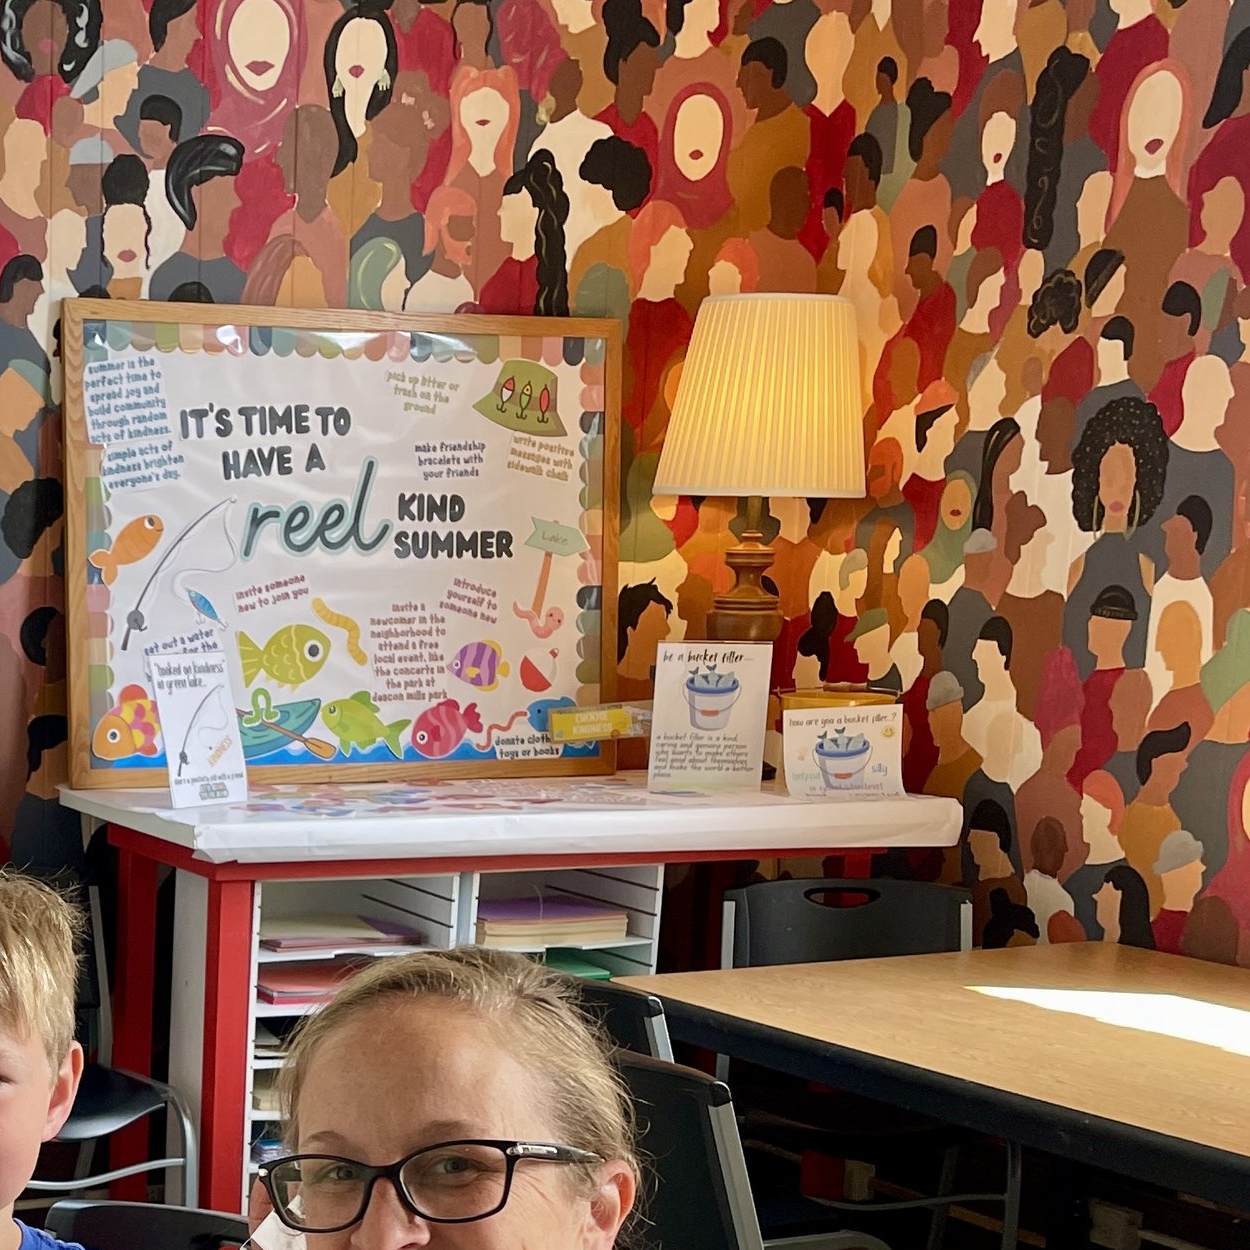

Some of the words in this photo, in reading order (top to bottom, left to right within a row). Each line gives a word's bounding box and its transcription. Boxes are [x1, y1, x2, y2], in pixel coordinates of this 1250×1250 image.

[88, 360, 125, 375] summer
[127, 359, 135, 369] is
[138, 356, 155, 368] the
[84, 374, 124, 391] perfect
[126, 372, 147, 383] time
[150, 369, 161, 380] to
[90, 387, 123, 403] spread
[124, 387, 141, 398] joy
[143, 383, 160, 394] and
[87, 403, 111, 417] build
[114, 397, 166, 414] community
[403, 400, 436, 416] ground
[91, 415, 130, 430] through
[132, 411, 167, 425] random
[180, 402, 234, 440] IT'S
[238, 405, 309, 437] TIME
[316, 405, 351, 436] TO
[90, 431, 111, 444] acts
[114, 429, 124, 440] of
[127, 425, 172, 438] kindness.
[107, 448, 136, 462] simple
[138, 444, 159, 456] acts
[161, 440, 173, 451] of
[414, 442, 437, 453] make
[439, 440, 486, 456] friendship
[513, 435, 536, 448] write
[538, 441, 575, 457] positive
[102, 463, 141, 477] kindness
[143, 454, 184, 470] brighten
[221, 445, 294, 480] HAVE
[304, 442, 327, 471] A
[417, 454, 460, 467] bracelets
[463, 453, 484, 464] with
[552, 457, 573, 470] with
[108, 472, 160, 489] everyone's
[423, 469, 443, 481] your
[446, 467, 479, 478] friends
[240, 457, 393, 560] reel
[398, 492, 466, 522] KIND
[394, 530, 513, 559] SUMMER
[236, 582, 263, 601] invite
[265, 574, 306, 593] someone
[453, 577, 497, 598] introduce
[237, 600, 256, 613] new
[258, 596, 269, 607] to
[271, 590, 291, 605] join
[293, 587, 309, 602] you
[392, 602, 418, 613] invite
[420, 604, 426, 612] a
[446, 589, 484, 608] yourself
[486, 600, 497, 611] to
[370, 615, 416, 626] newcomer
[418, 614, 428, 624] in
[430, 615, 445, 625] the
[439, 599, 478, 620] someone
[479, 612, 497, 625] new
[161, 637, 177, 650] out
[180, 636, 186, 645] a
[187, 629, 214, 643] water
[370, 626, 434, 641] neighborhood
[435, 627, 446, 636] to
[201, 641, 218, 653] the
[378, 640, 408, 651] attend
[411, 641, 417, 650] a
[418, 640, 439, 650] free
[374, 653, 396, 664] local
[429, 652, 444, 662] like
[687, 648, 717, 665] bucket
[374, 666, 391, 677] the
[393, 666, 434, 676] concerts
[437, 665, 445, 674] in
[386, 679, 401, 688] the
[404, 679, 425, 691] park
[427, 678, 435, 687] at
[372, 693, 404, 703] deacon
[406, 691, 426, 701] mills
[428, 690, 447, 703] park
[843, 714, 869, 724] bucket
[495, 735, 525, 746] donate
[527, 733, 551, 745] cloth
[499, 748, 519, 759] toys
[522, 748, 531, 757] or
[533, 746, 560, 758] books
